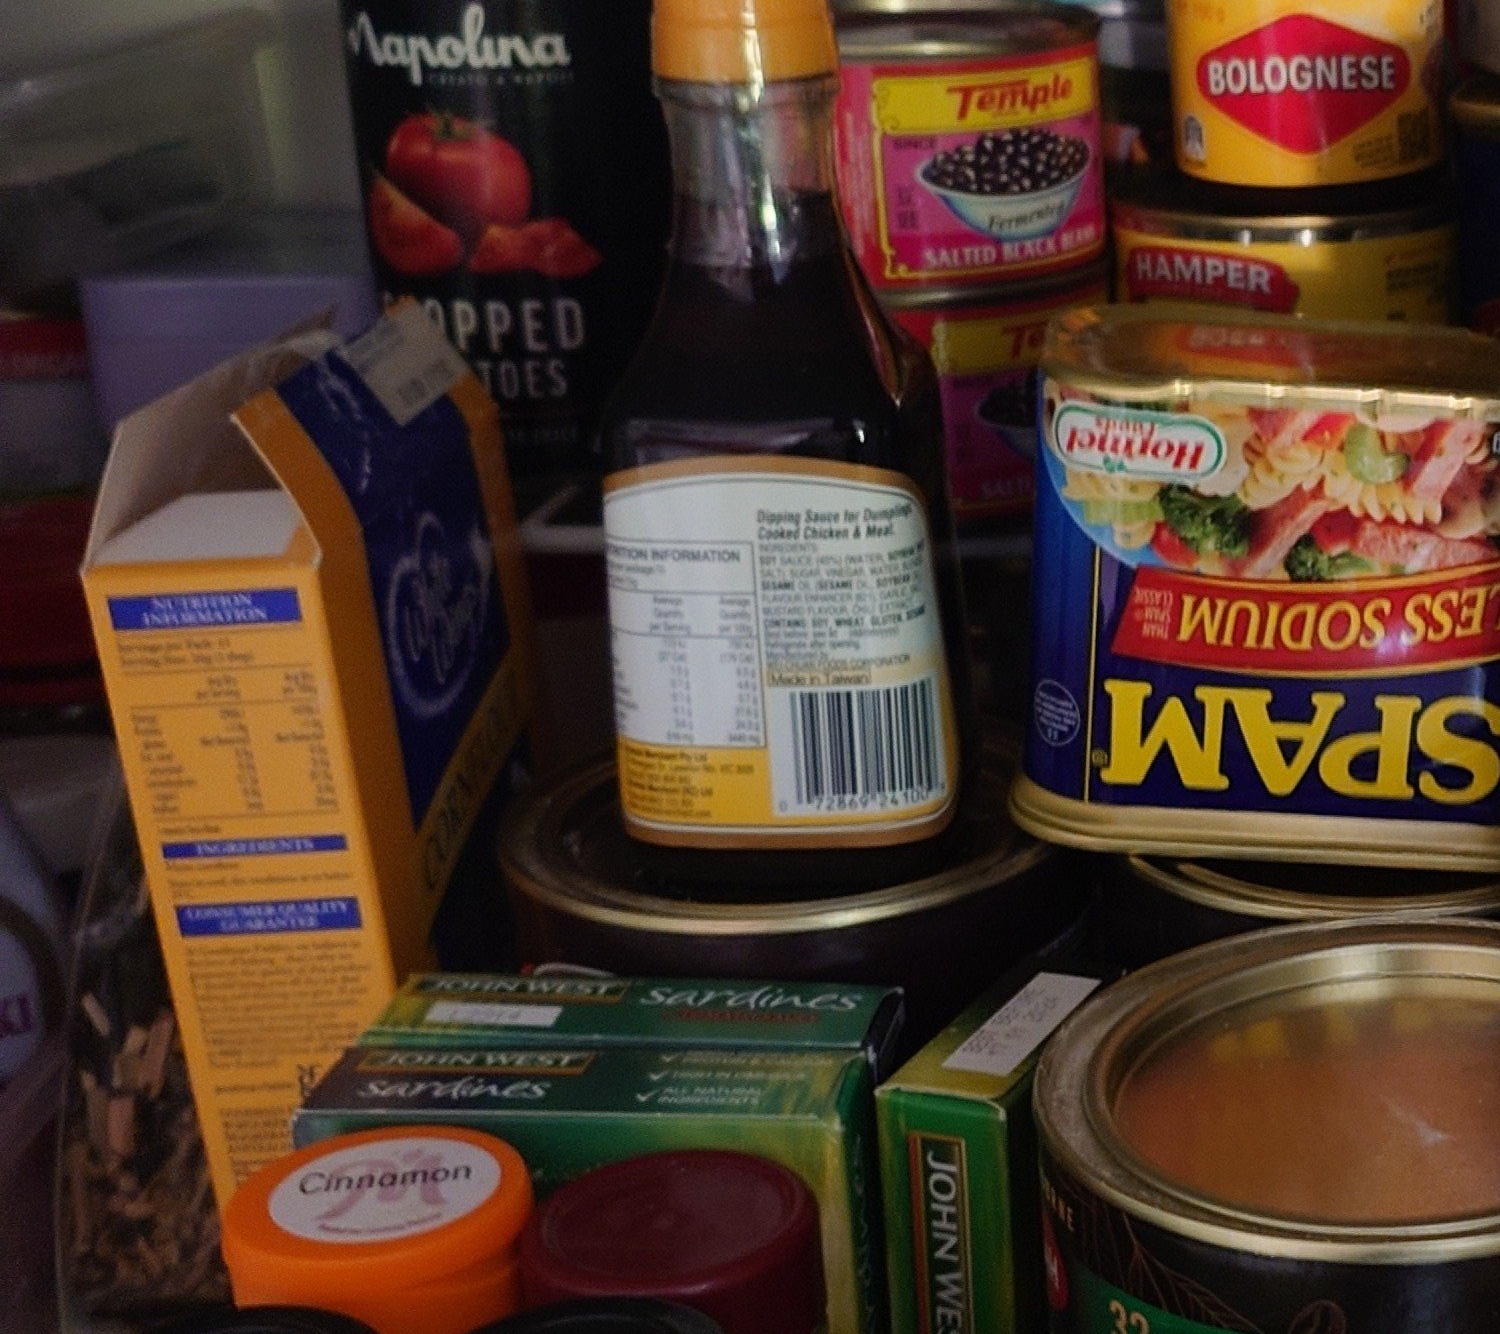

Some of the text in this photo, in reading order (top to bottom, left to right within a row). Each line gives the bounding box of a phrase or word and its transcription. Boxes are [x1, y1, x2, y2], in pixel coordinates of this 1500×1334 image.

[348, 2, 571, 85] Napolina
[1207, 54, 1396, 98] BOLOGNESE
[945, 72, 1073, 123] Temple
[922, 239, 998, 268] SALTED
[1001, 231, 1056, 259] BLACK
[1134, 251, 1272, 296] HAMPER
[385, 293, 586, 354] OPPED
[476, 357, 569, 399] TOES
[1065, 425, 1205, 472] Hormel
[757, 508, 801, 526] Dipping
[804, 507, 840, 522] Sauce
[843, 508, 860, 520] for
[757, 526, 801, 540] Cooked
[803, 525, 849, 540] Chicken
[853, 524, 862, 540] &
[651, 549, 741, 563] INFORMATION
[1178, 593, 1391, 652] SODIUM
[771, 672, 807, 685] Made
[810, 672, 821, 684] in
[639, 985, 864, 1011] Sardines
[356, 1075, 551, 1100] Sardines
[299, 1160, 473, 1196] Cinnamon
[927, 1150, 961, 1262] JOHN
